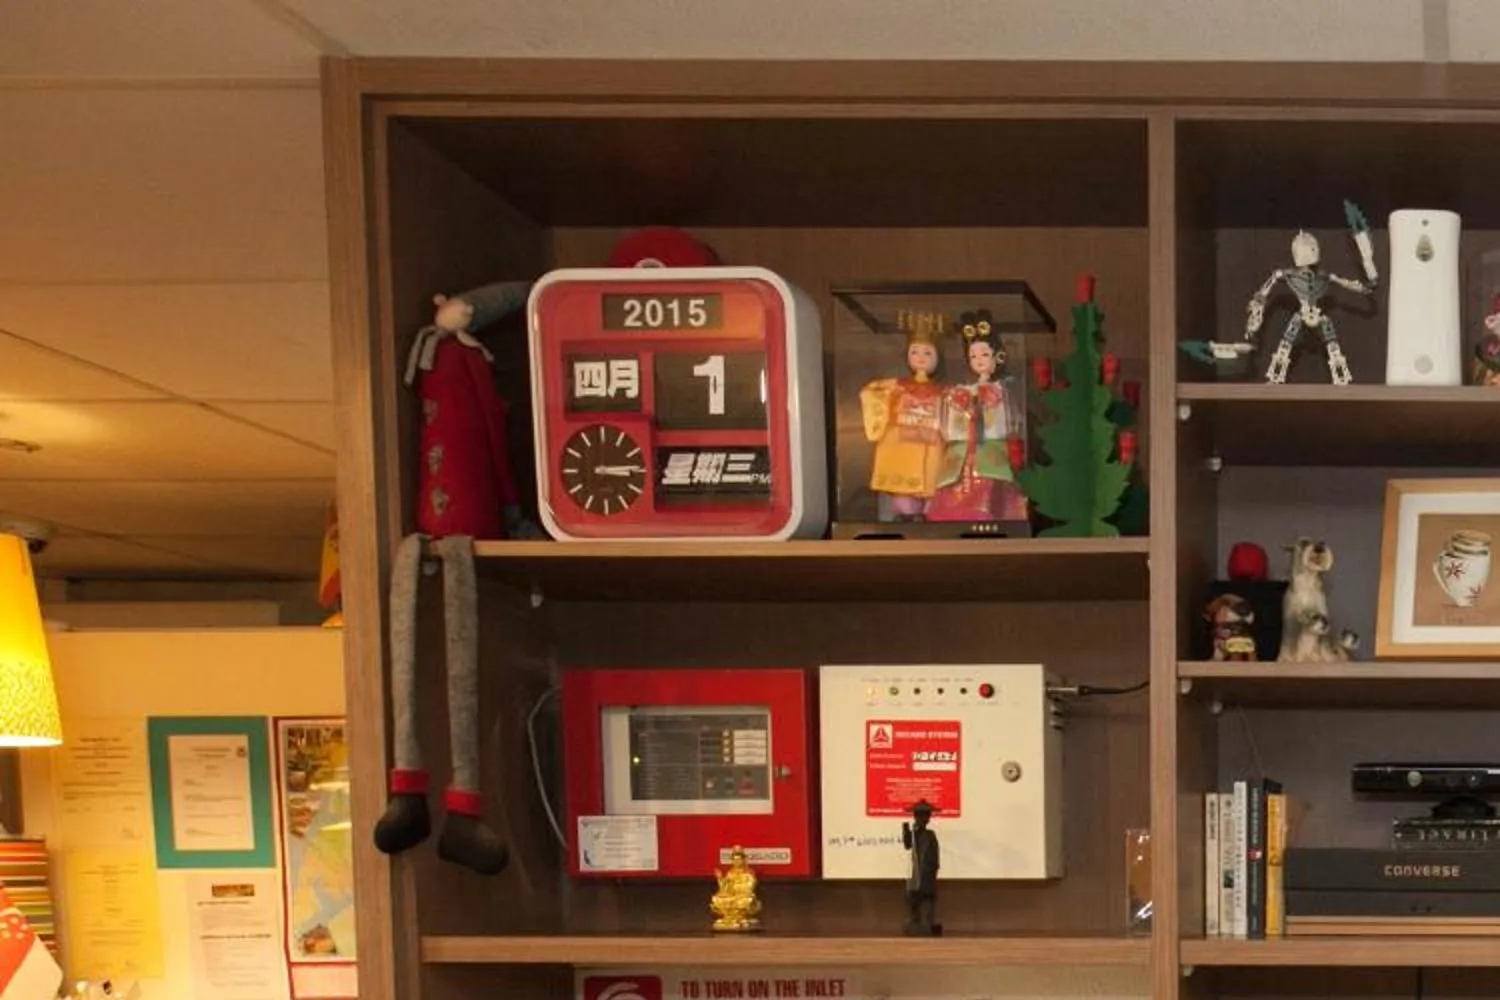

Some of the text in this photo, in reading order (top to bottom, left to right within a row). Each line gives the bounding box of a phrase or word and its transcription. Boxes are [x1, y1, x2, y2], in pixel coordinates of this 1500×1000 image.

[623, 300, 707, 327] 2015
[573, 360, 640, 399] 四月
[693, 355, 726, 415] 1
[661, 453, 755, 484] 星期三
[1383, 864, 1461, 877] CONVERSE
[680, 978, 846, 998] TO TURN ON THE INLET
